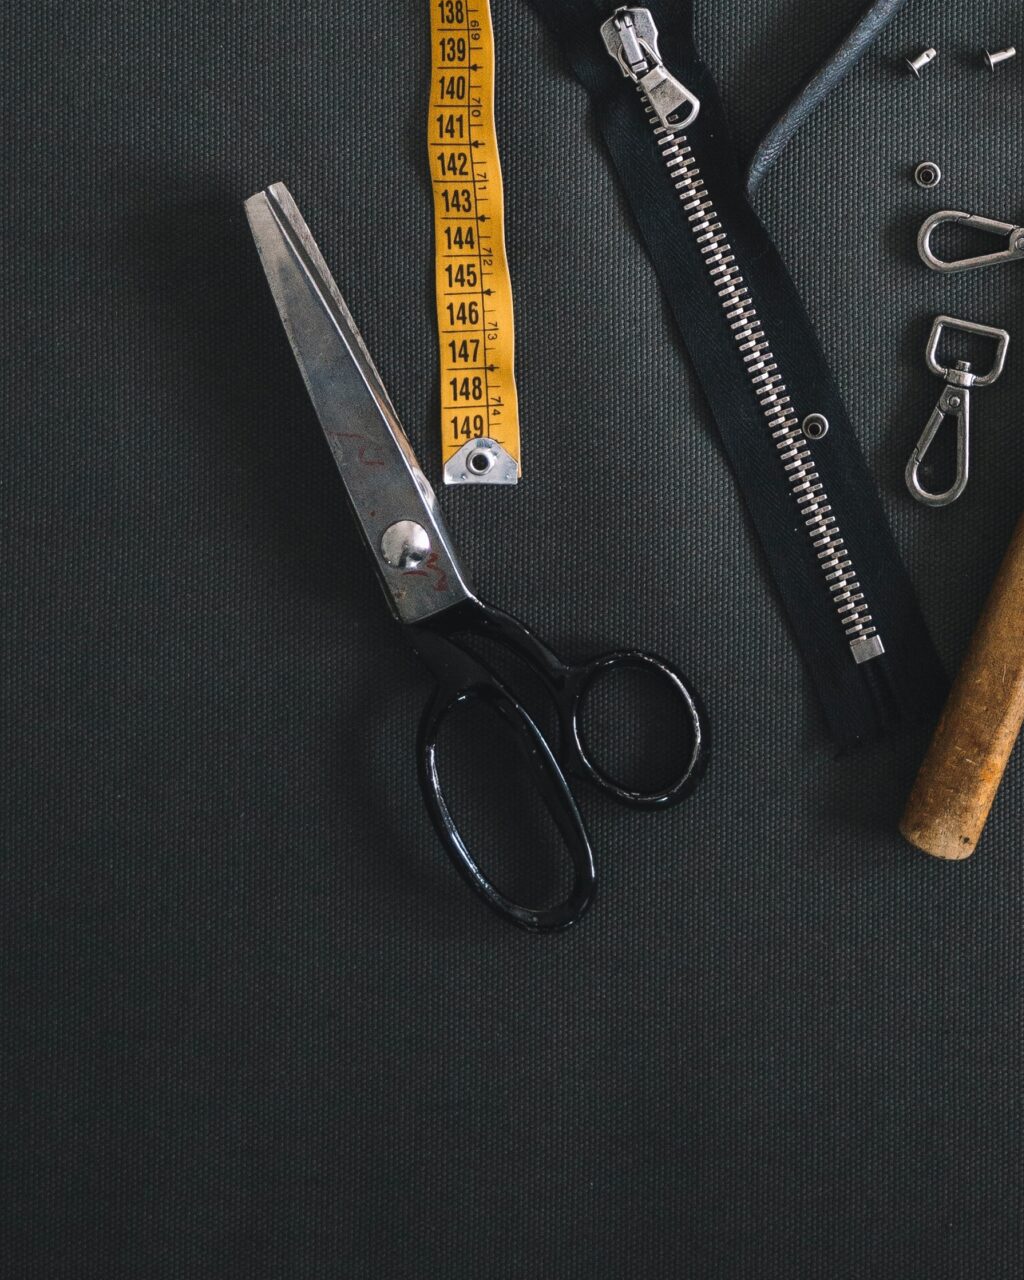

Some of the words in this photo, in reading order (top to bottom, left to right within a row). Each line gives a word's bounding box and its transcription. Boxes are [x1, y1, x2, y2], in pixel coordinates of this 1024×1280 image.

[438, 0, 464, 24] 138
[470, 20, 480, 41] 69
[439, 37, 466, 62] 139
[438, 75, 465, 100] 140
[436, 114, 464, 139] 141
[437, 152, 469, 176] 142
[441, 189, 472, 213] 143
[444, 226, 475, 250] 144
[444, 263, 477, 288] 145
[446, 301, 479, 326] 146
[448, 338, 480, 363] 147
[449, 376, 483, 401] 148
[450, 414, 484, 440] 149
